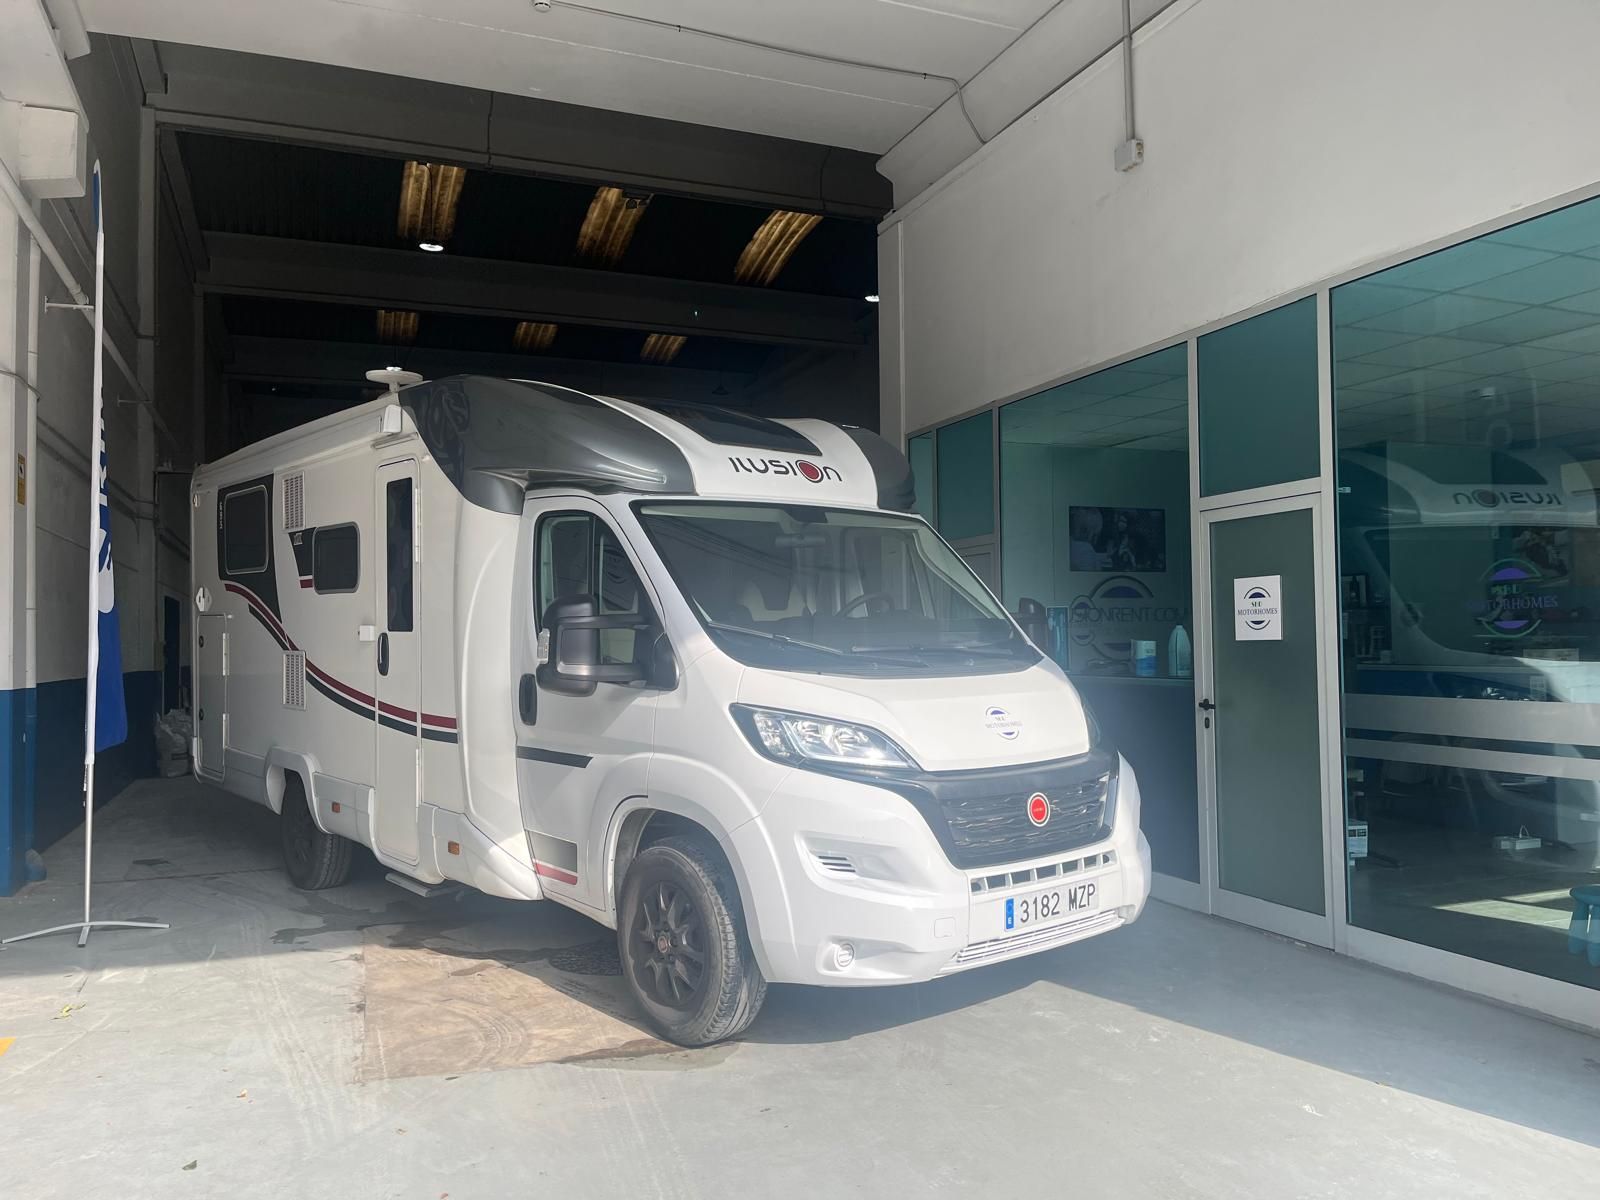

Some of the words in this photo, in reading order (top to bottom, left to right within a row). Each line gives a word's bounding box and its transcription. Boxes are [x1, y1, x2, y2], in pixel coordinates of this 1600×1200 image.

[1237, 608, 1278, 616] MOTORHOMES
[1466, 595, 1559, 614] TORHOMES
[1020, 893, 1060, 923] 3182
[1068, 883, 1096, 912] MZP
